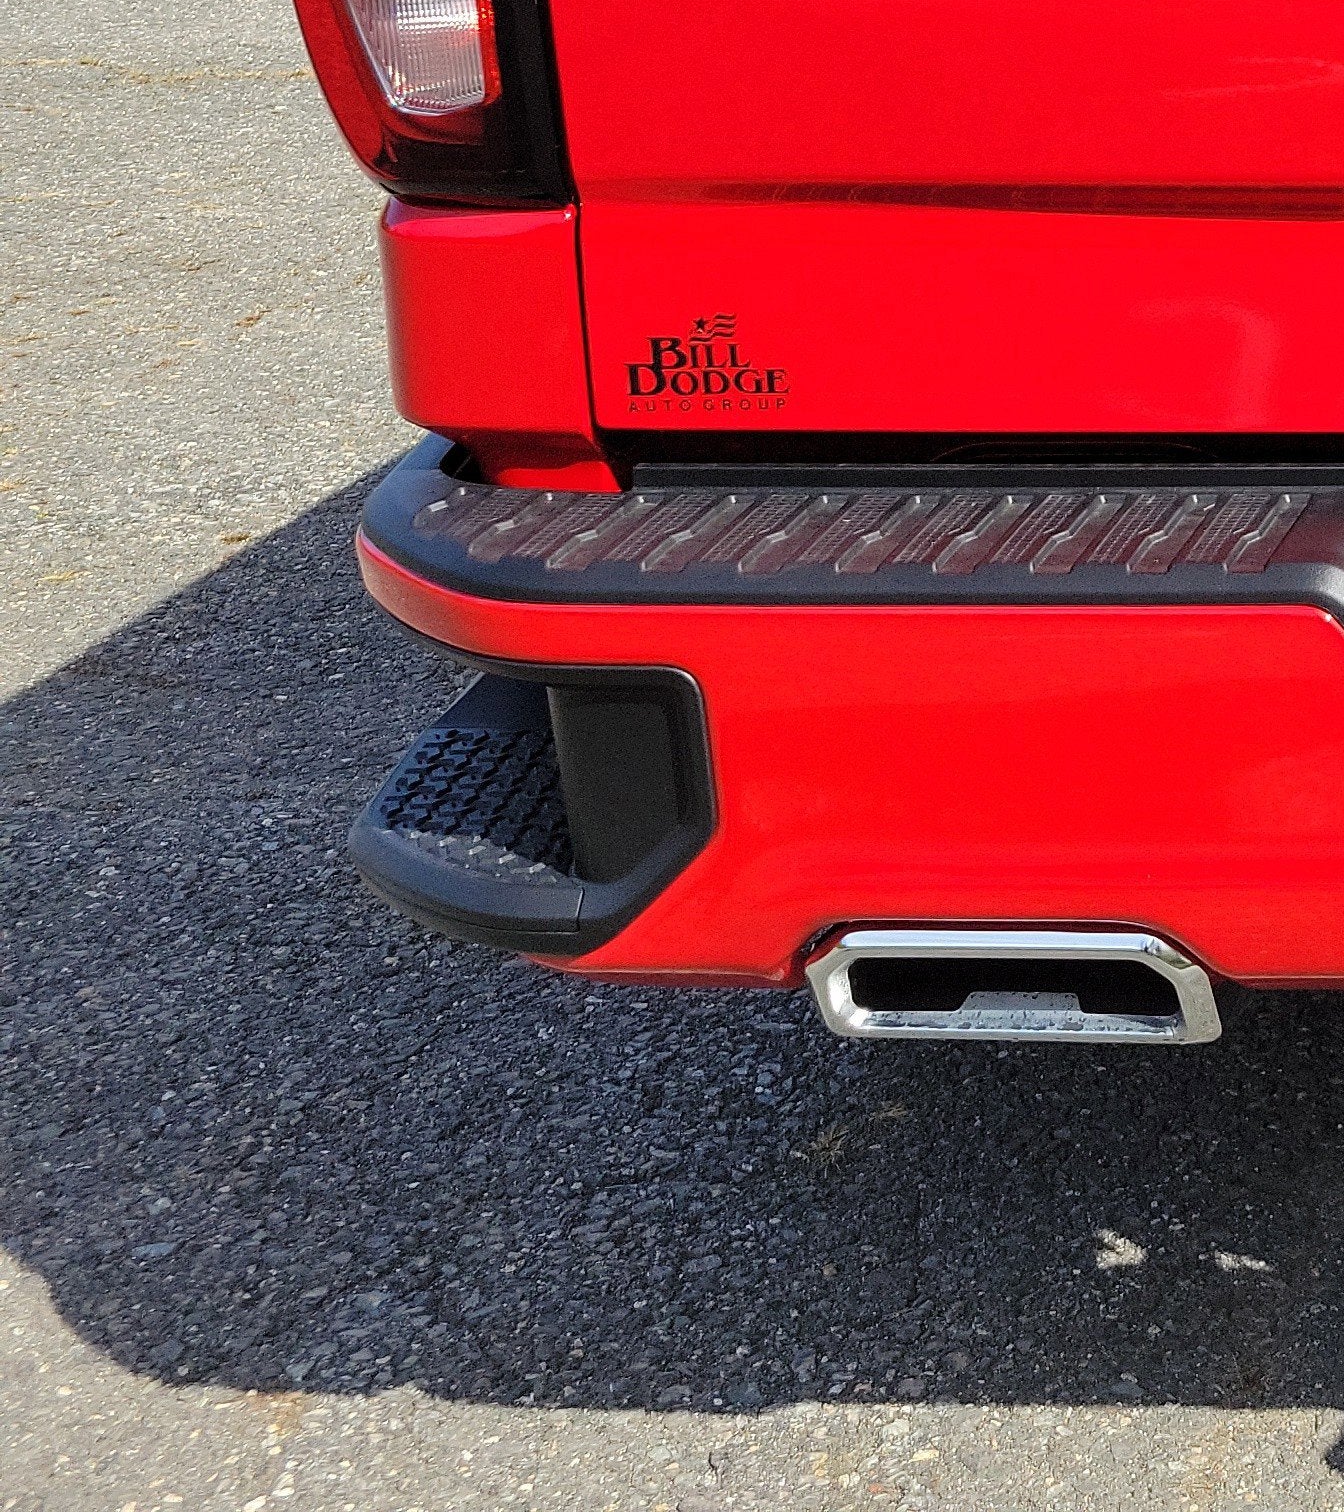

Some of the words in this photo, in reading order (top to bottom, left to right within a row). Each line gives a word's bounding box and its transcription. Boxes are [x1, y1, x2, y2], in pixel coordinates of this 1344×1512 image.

[648, 336, 750, 370] BILL
[625, 362, 790, 397] DODGE
[628, 399, 692, 413] AUTO
[702, 398, 787, 412] GROUP
